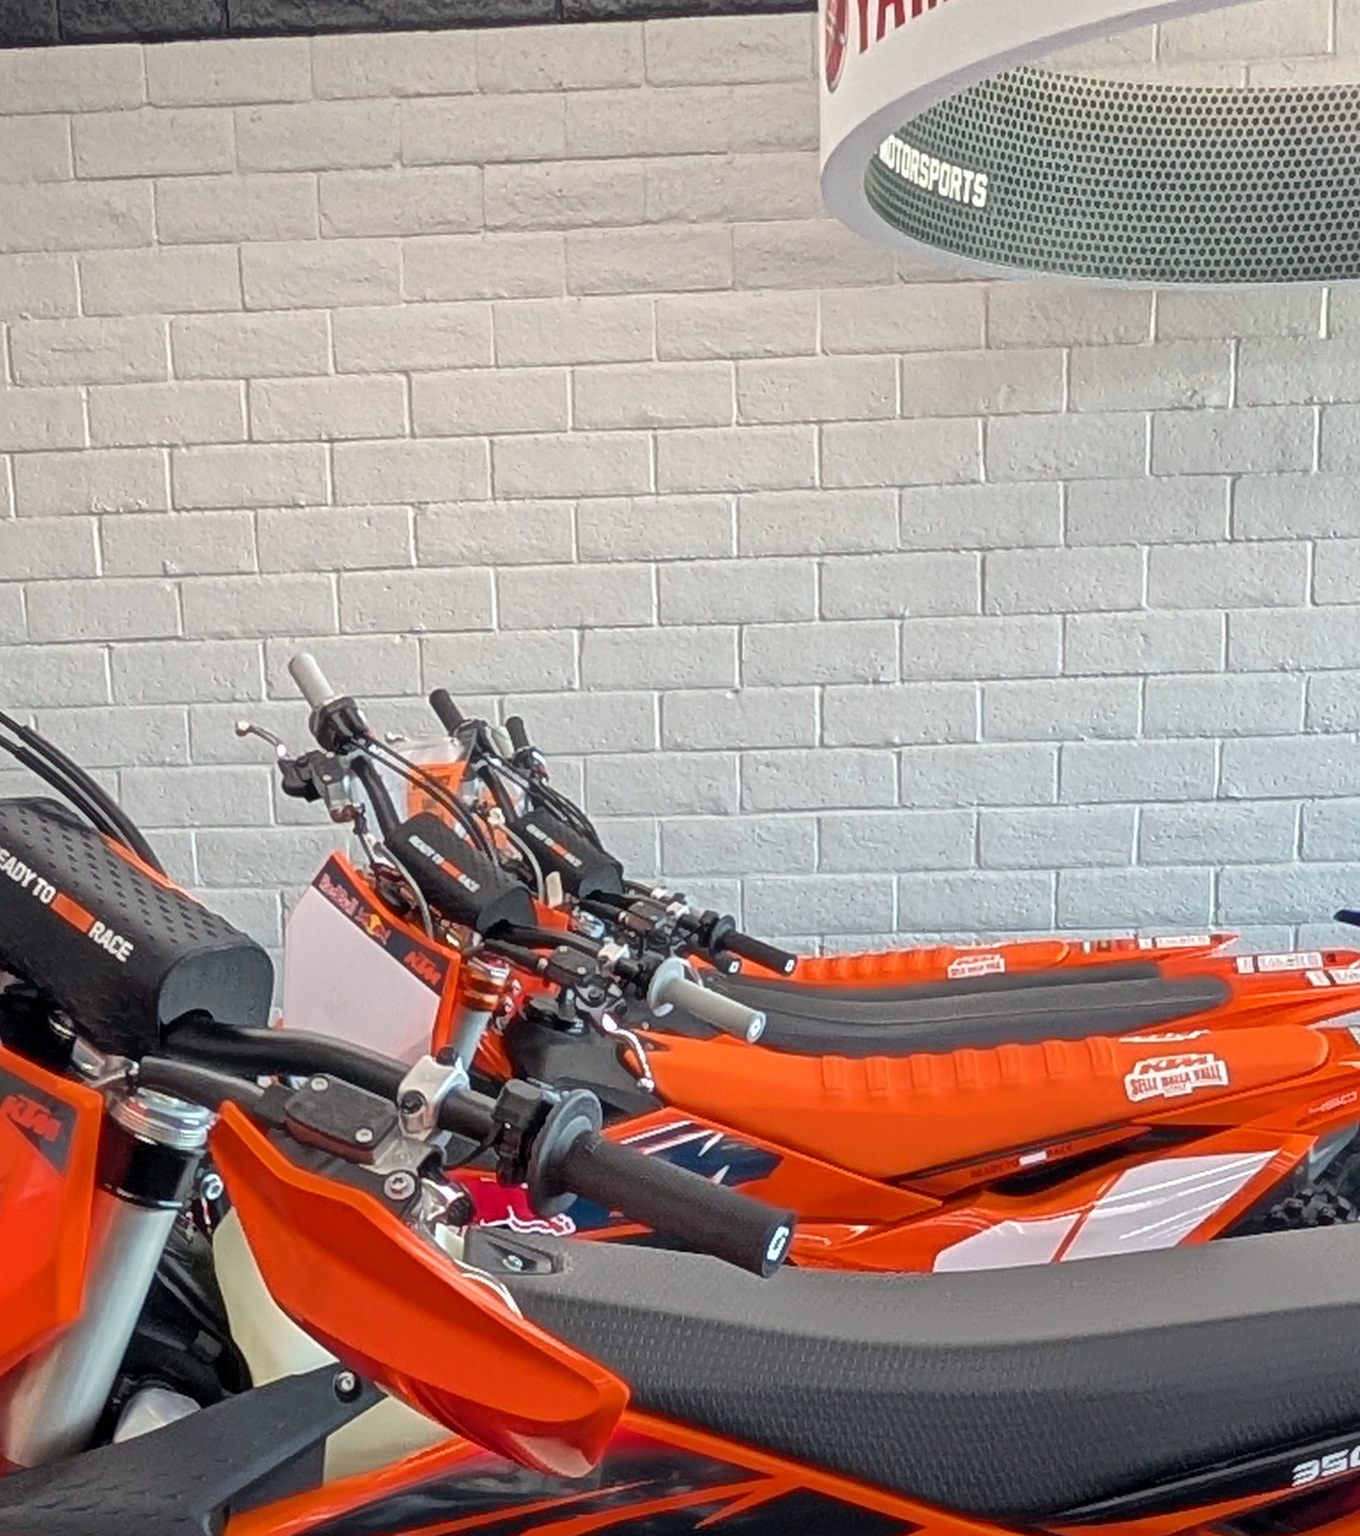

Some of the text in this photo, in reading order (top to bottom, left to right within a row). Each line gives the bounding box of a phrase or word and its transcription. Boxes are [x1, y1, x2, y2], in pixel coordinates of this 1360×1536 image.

[32, 876, 57, 904] TO
[88, 921, 134, 962] RACE
[1, 1094, 61, 1142] KTM
